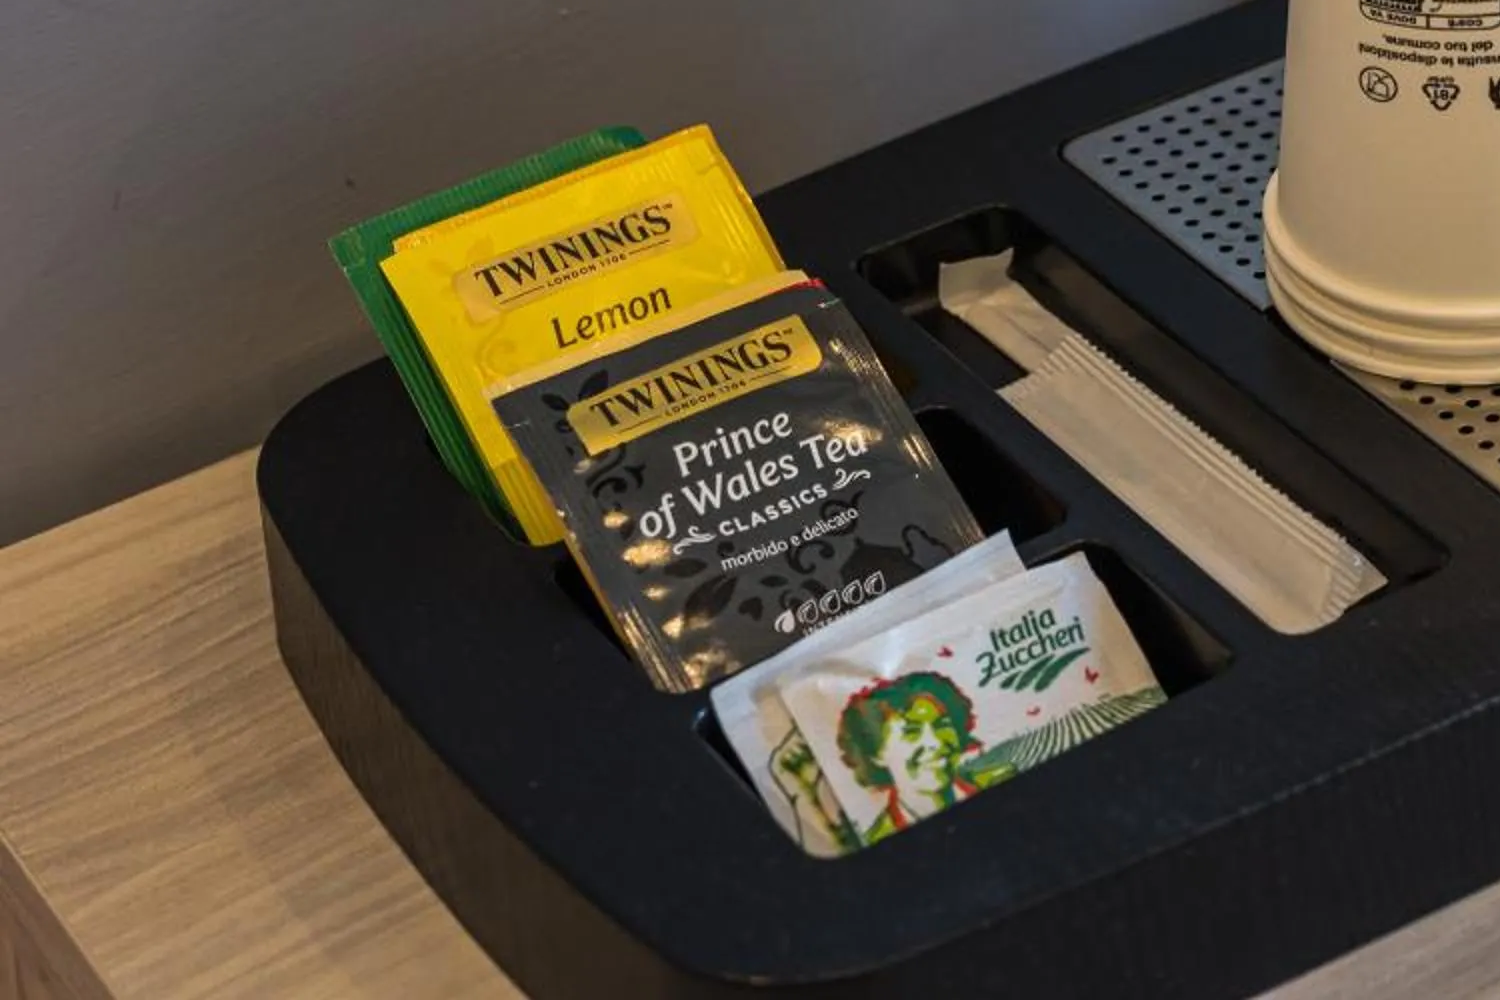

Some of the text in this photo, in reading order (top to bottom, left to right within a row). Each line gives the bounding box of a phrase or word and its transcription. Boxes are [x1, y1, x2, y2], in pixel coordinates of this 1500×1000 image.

[1358, 42, 1437, 66] disposizioni
[1381, 34, 1494, 51] del tuo comune.
[1441, 55, 1455, 68] le
[474, 203, 673, 297] TWININGS
[547, 263, 597, 288] LONDON
[551, 286, 672, 349] Lemon
[589, 330, 794, 428] TWININGS
[664, 391, 716, 418] LONDON
[673, 412, 793, 478] Prince
[640, 432, 869, 539] of Wales Tea
[719, 482, 828, 537] CLASSICS
[720, 506, 860, 571] morbido e delicato
[975, 615, 1085, 688] Zuccheri
[989, 607, 1057, 652] Italia
